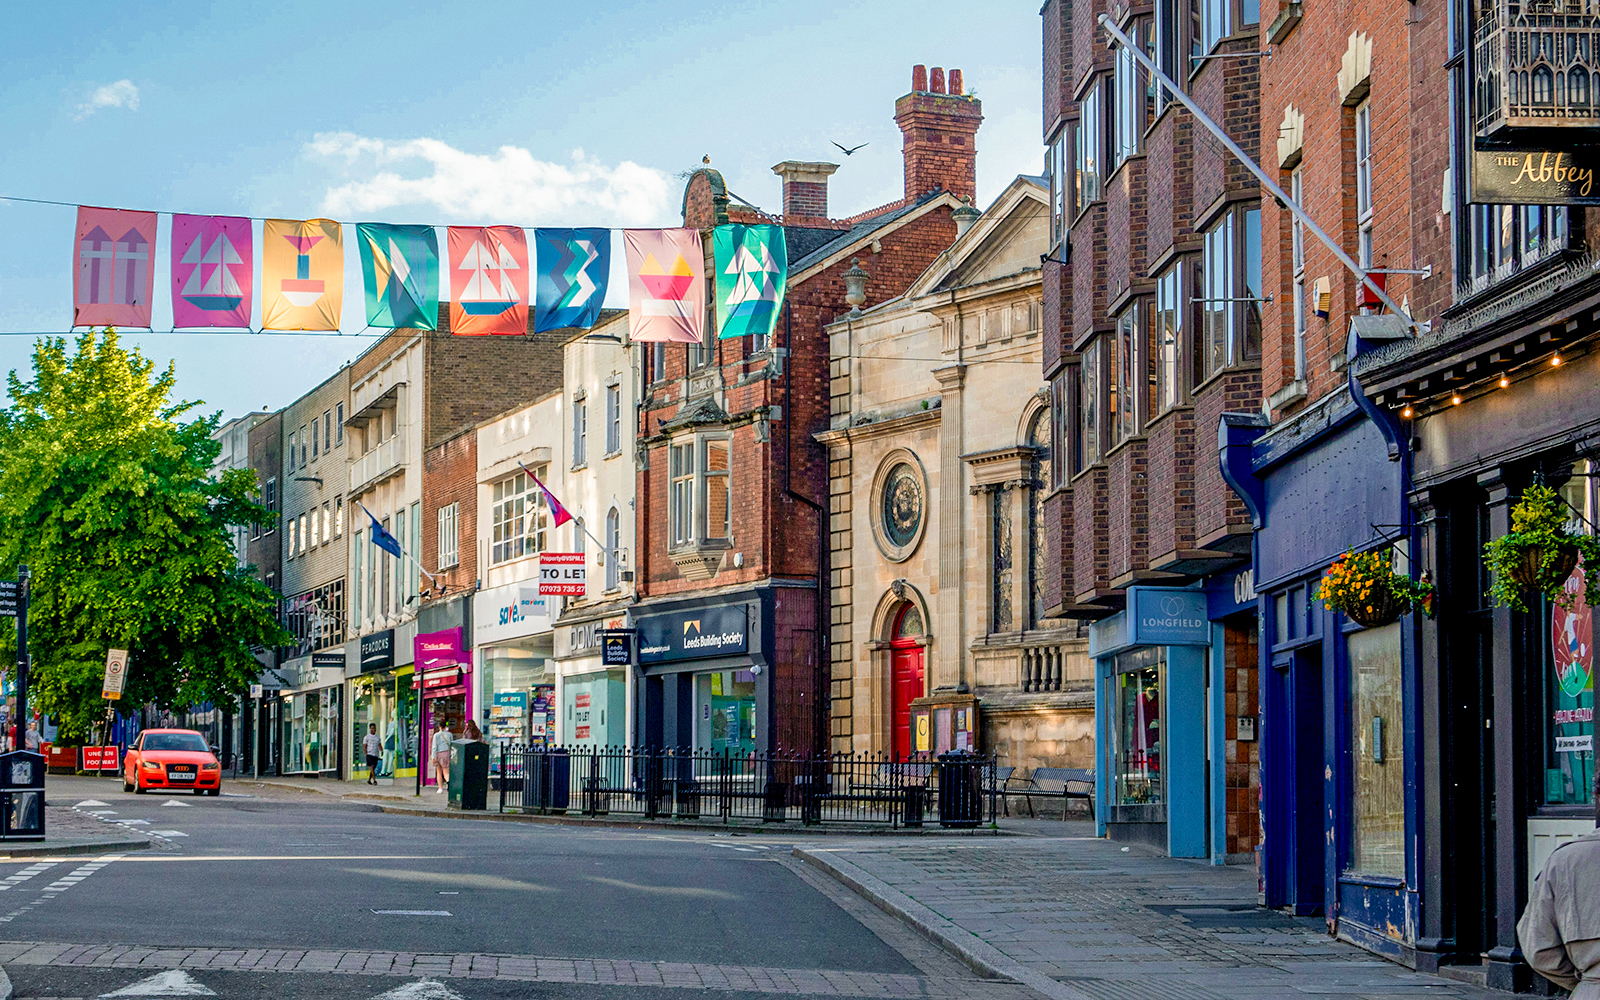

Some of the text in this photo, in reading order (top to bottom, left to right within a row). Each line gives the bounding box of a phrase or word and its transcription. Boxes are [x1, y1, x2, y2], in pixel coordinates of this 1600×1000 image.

[1496, 150, 1593, 196] THE Abbey
[541, 568, 586, 579] TO LET
[563, 585, 576, 593] 735
[1143, 618, 1202, 628] LONGFIELD
[361, 637, 389, 655] PEACOCKS
[683, 632, 744, 649] Leeds Building Society
